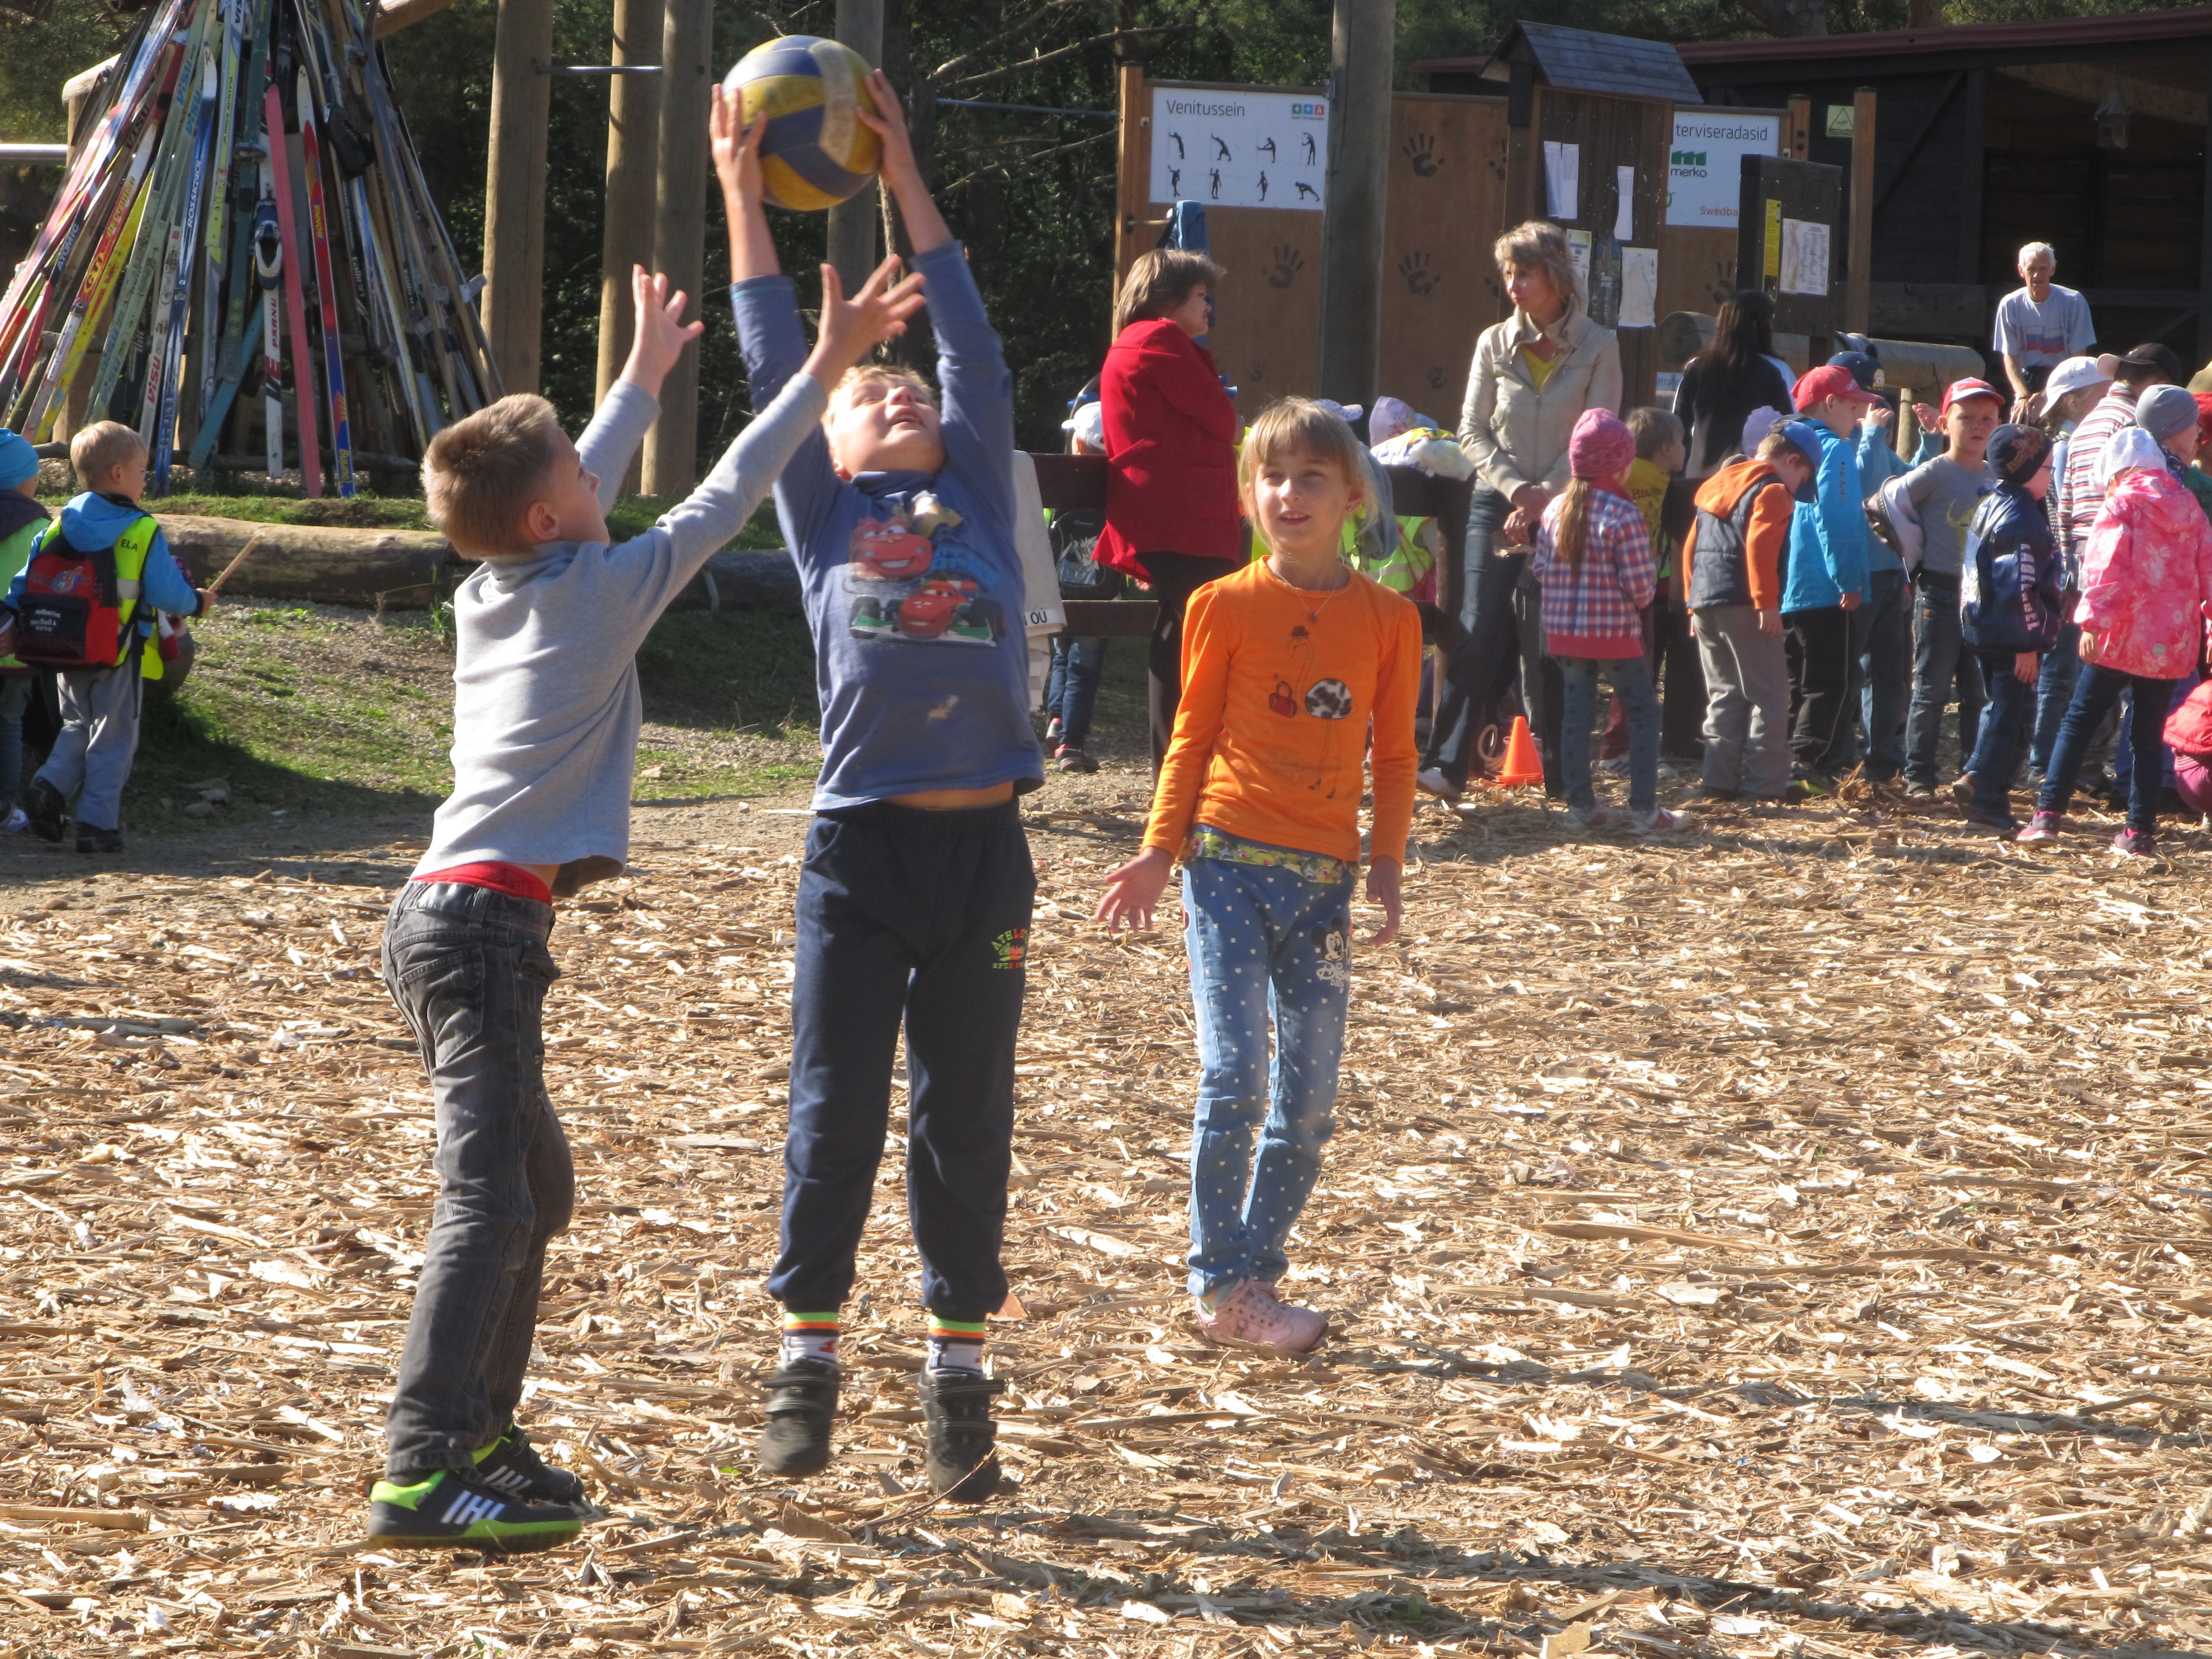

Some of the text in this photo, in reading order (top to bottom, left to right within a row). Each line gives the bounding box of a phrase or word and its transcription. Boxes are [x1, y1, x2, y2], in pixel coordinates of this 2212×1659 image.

[1166, 99, 1245, 117] Venitussein
[1676, 123, 1768, 140] terviseradasid
[1670, 166, 1707, 178] merko
[186, 158, 204, 228] ROSSIGNOL
[312, 203, 322, 239] BONNA
[56, 222, 81, 272] ATOMIC
[120, 538, 138, 552] ELA
